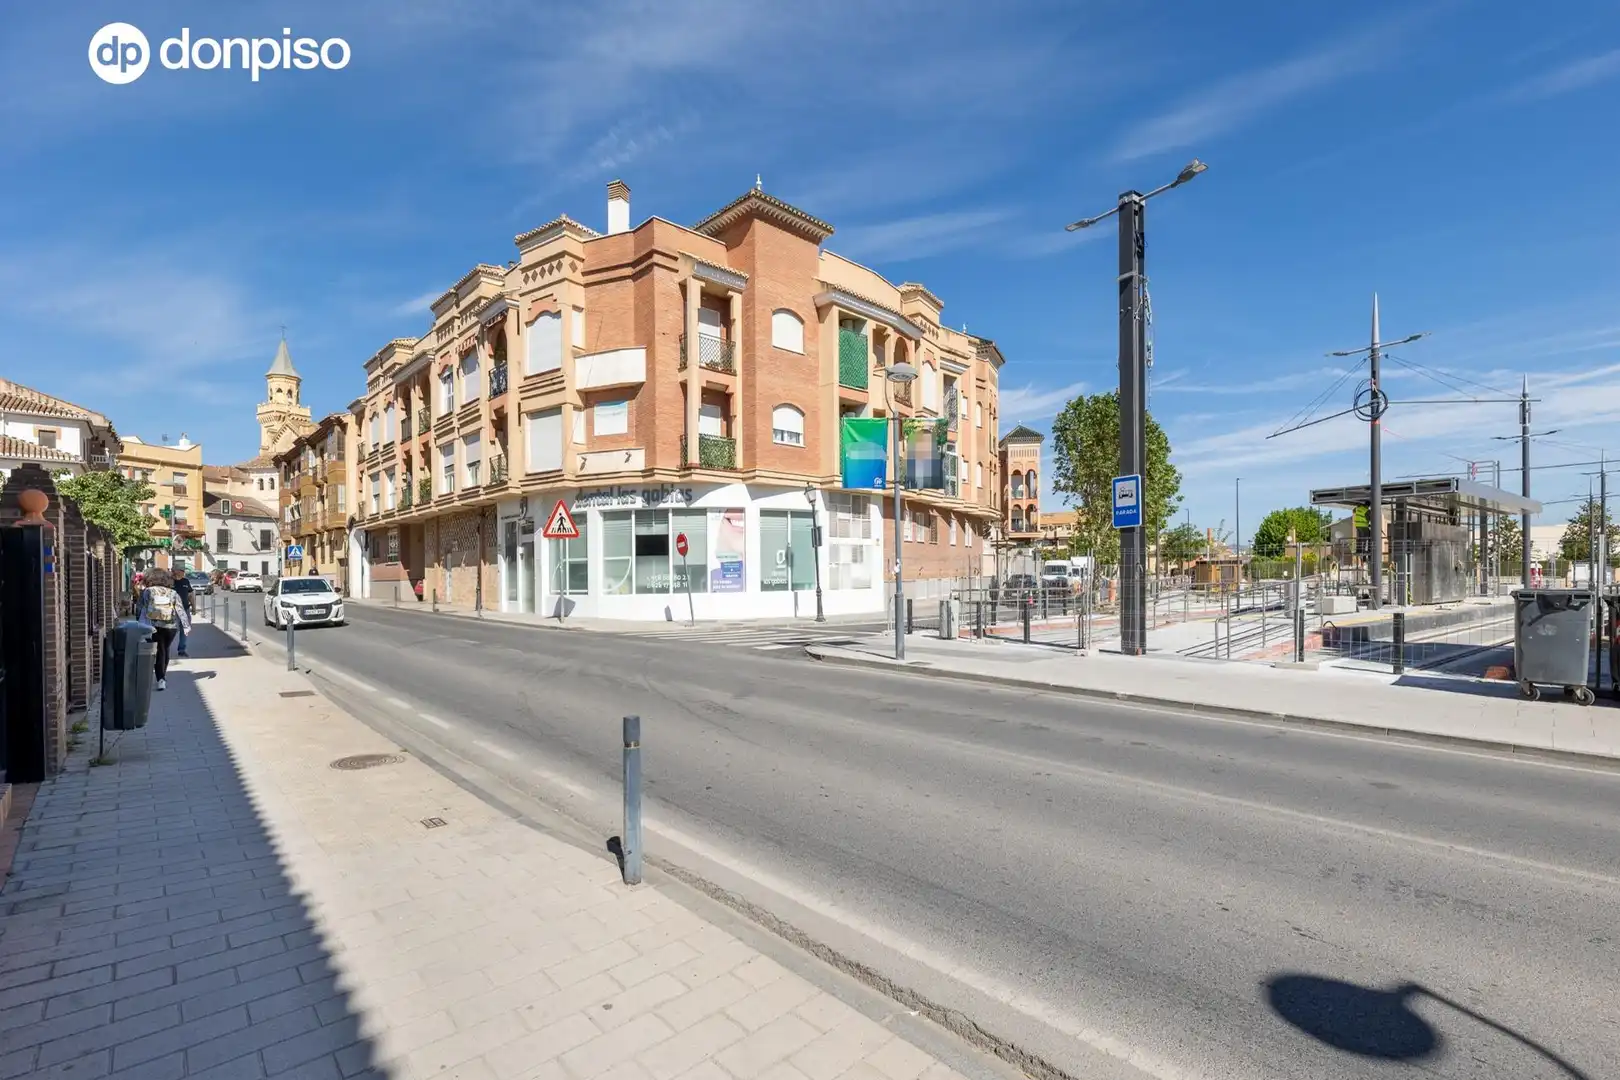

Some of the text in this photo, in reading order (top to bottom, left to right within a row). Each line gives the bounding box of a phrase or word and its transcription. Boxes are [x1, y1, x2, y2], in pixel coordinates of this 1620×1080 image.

[617, 485, 637, 506] las
[641, 483, 693, 507] gabias
[1115, 508, 1137, 516] PARADA
